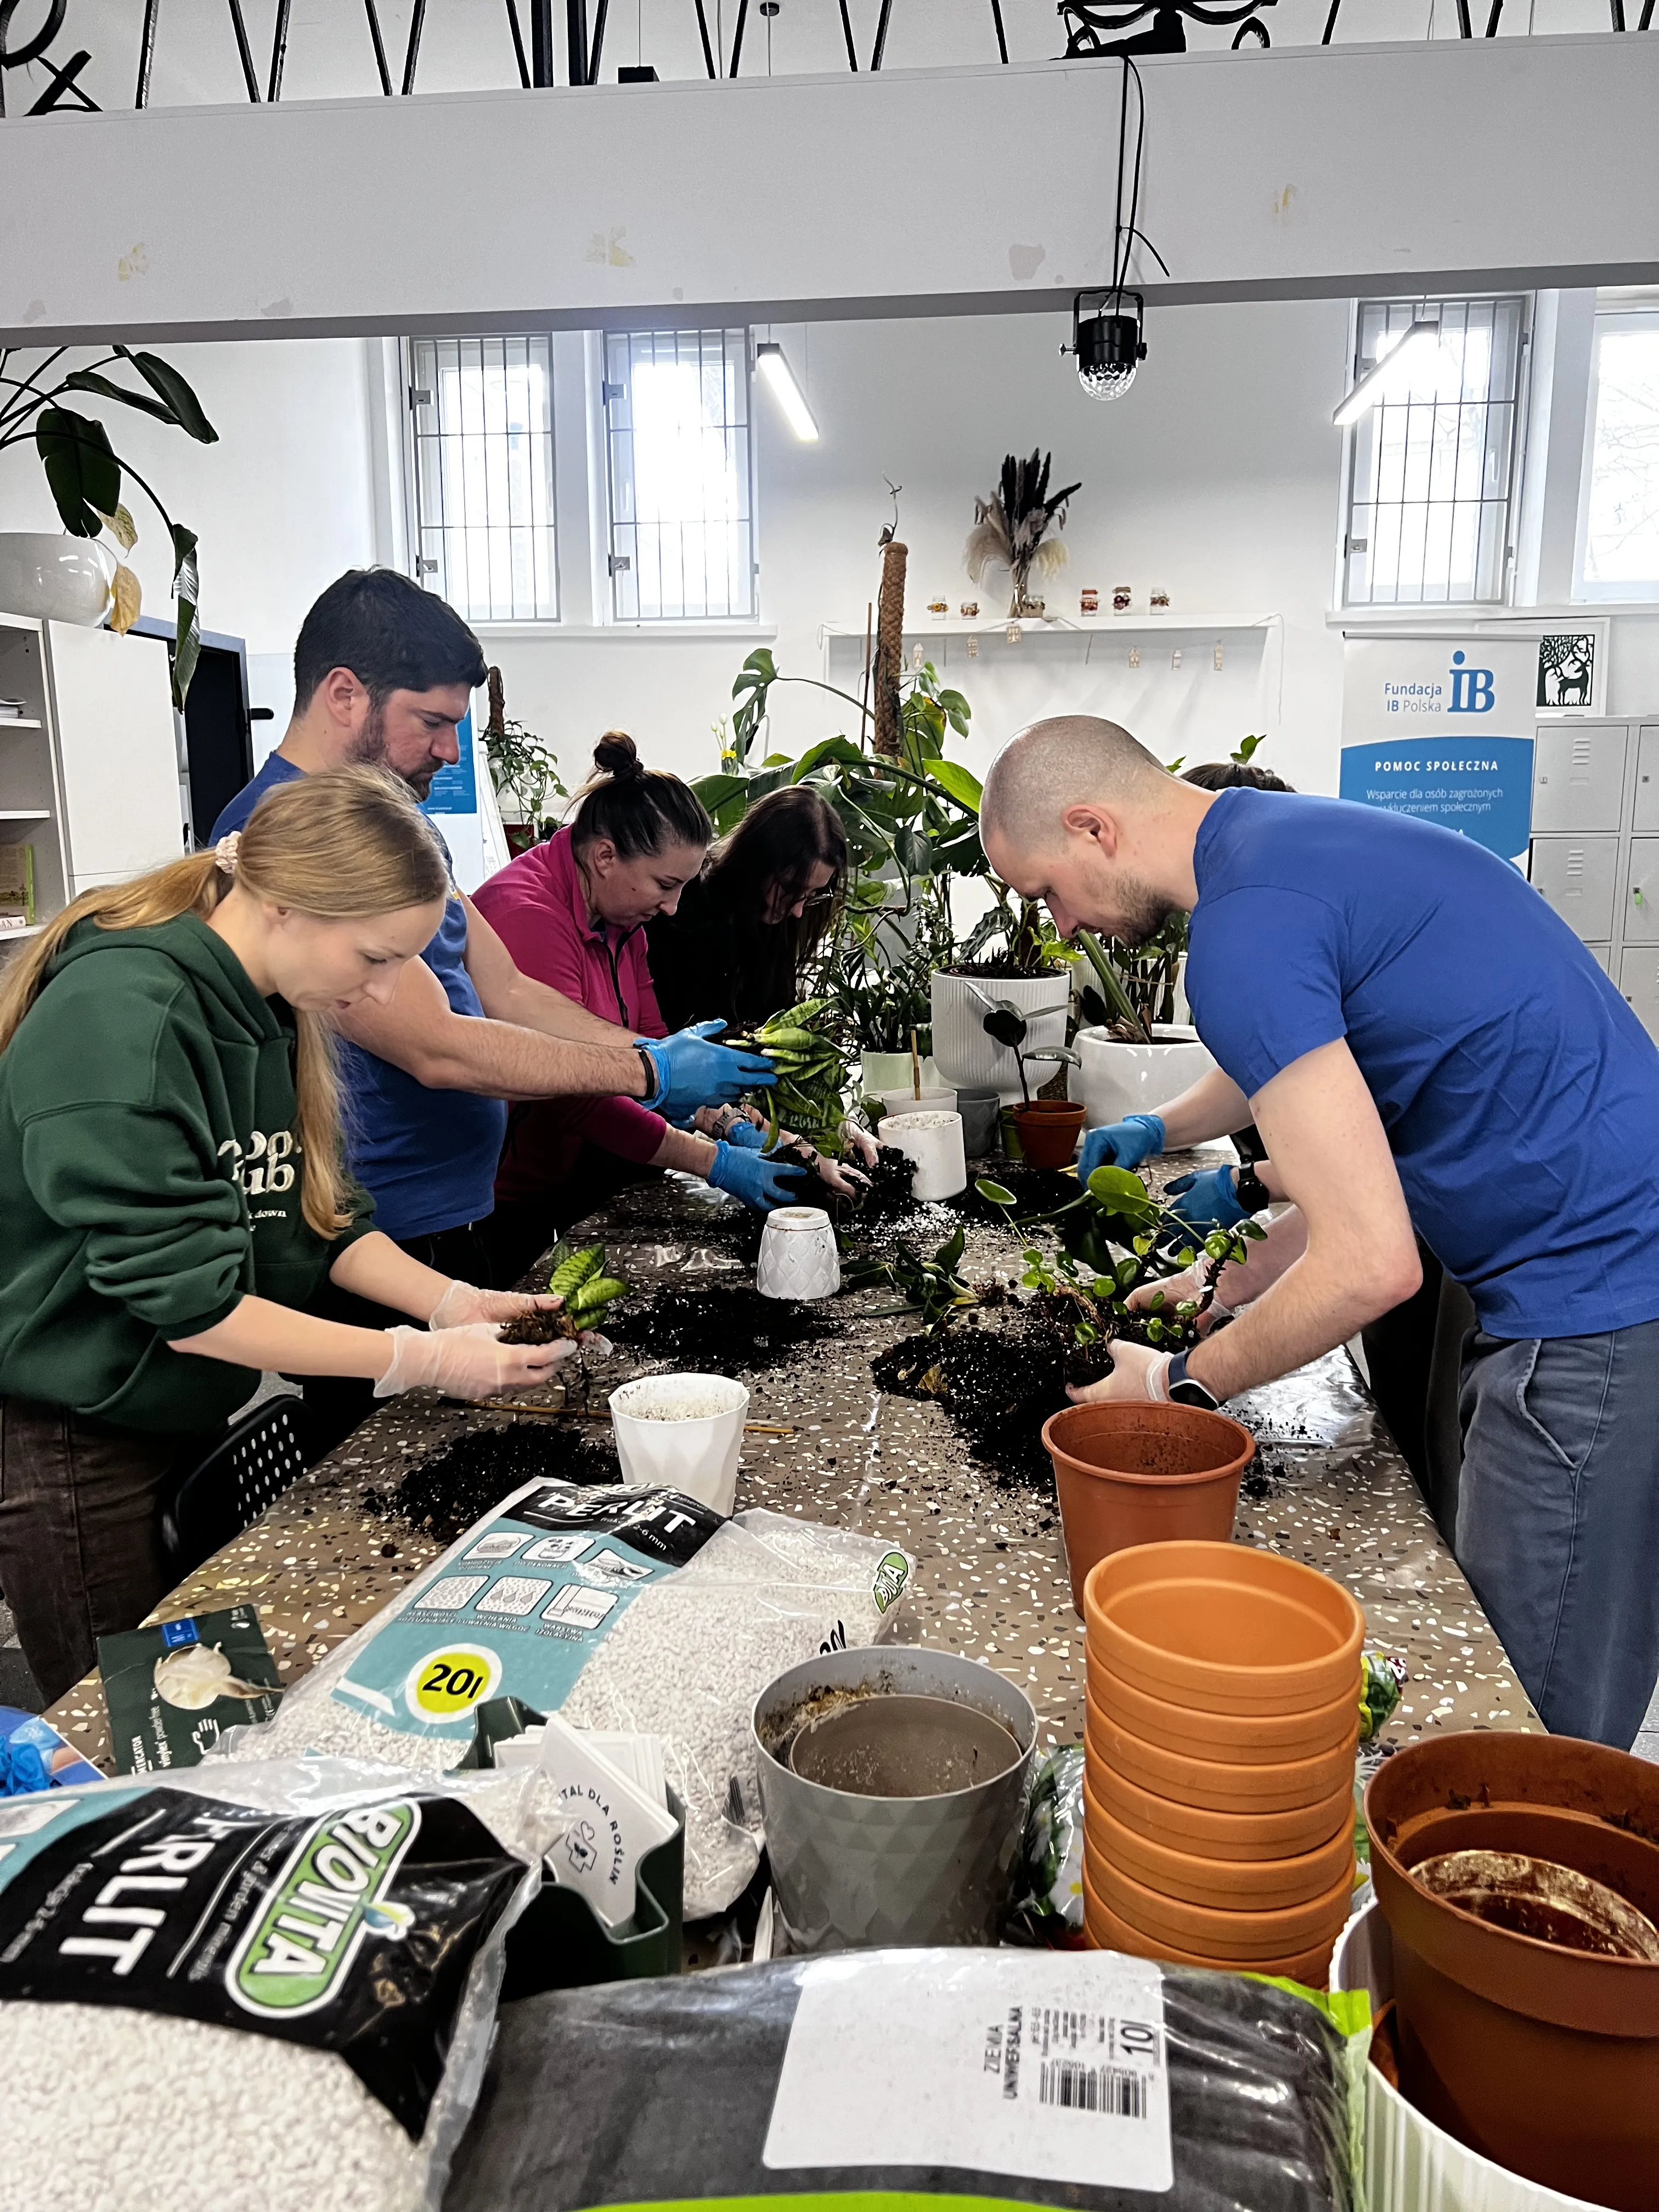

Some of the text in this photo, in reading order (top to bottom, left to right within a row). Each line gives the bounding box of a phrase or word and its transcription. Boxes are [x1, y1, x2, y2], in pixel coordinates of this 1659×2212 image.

[1384, 682, 1442, 699] Fundacja
[1387, 699, 1442, 713] IB Polska
[1375, 760, 1498, 771] POMOC SPOŁECZNA
[1367, 788, 1503, 802] Wsparcie dla osób zagrożonych
[1440, 802, 1491, 814] społecznym
[648, 1534, 667, 1551] mm
[588, 1787, 610, 1817] DLA
[253, 1809, 404, 1973] BIOVITA
